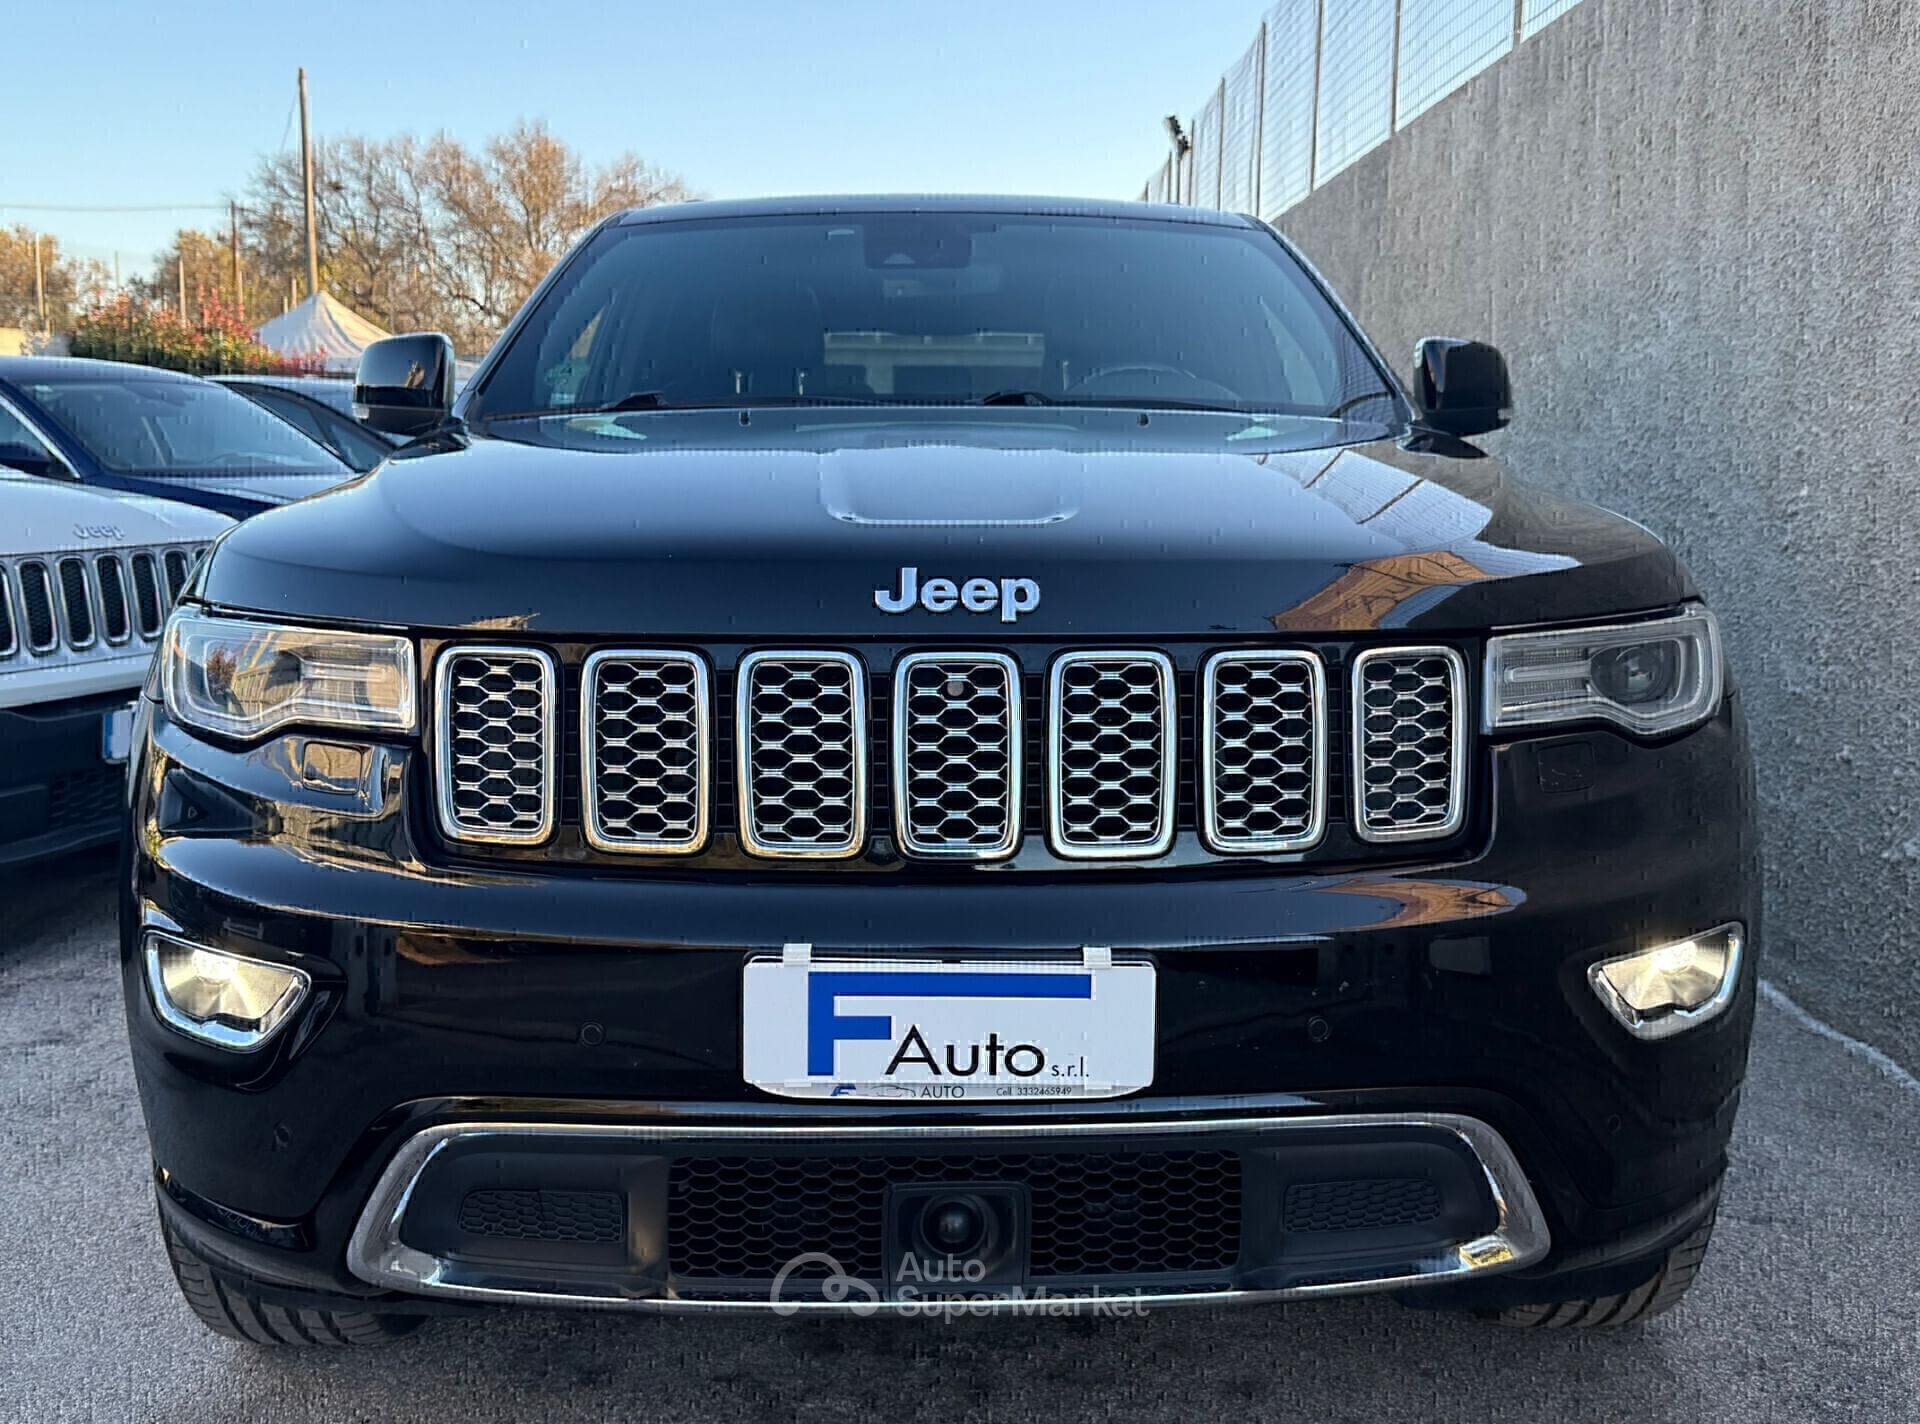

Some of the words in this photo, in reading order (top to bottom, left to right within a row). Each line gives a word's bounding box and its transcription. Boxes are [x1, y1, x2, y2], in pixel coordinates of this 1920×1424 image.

[73, 523, 125, 541] Jeep
[874, 567, 1040, 622] Jeep
[808, 971, 1092, 1076] F
[885, 1024, 1045, 1077] Auto
[1051, 1056, 1090, 1078] s.r.l.
[920, 1085, 965, 1099] AUTO
